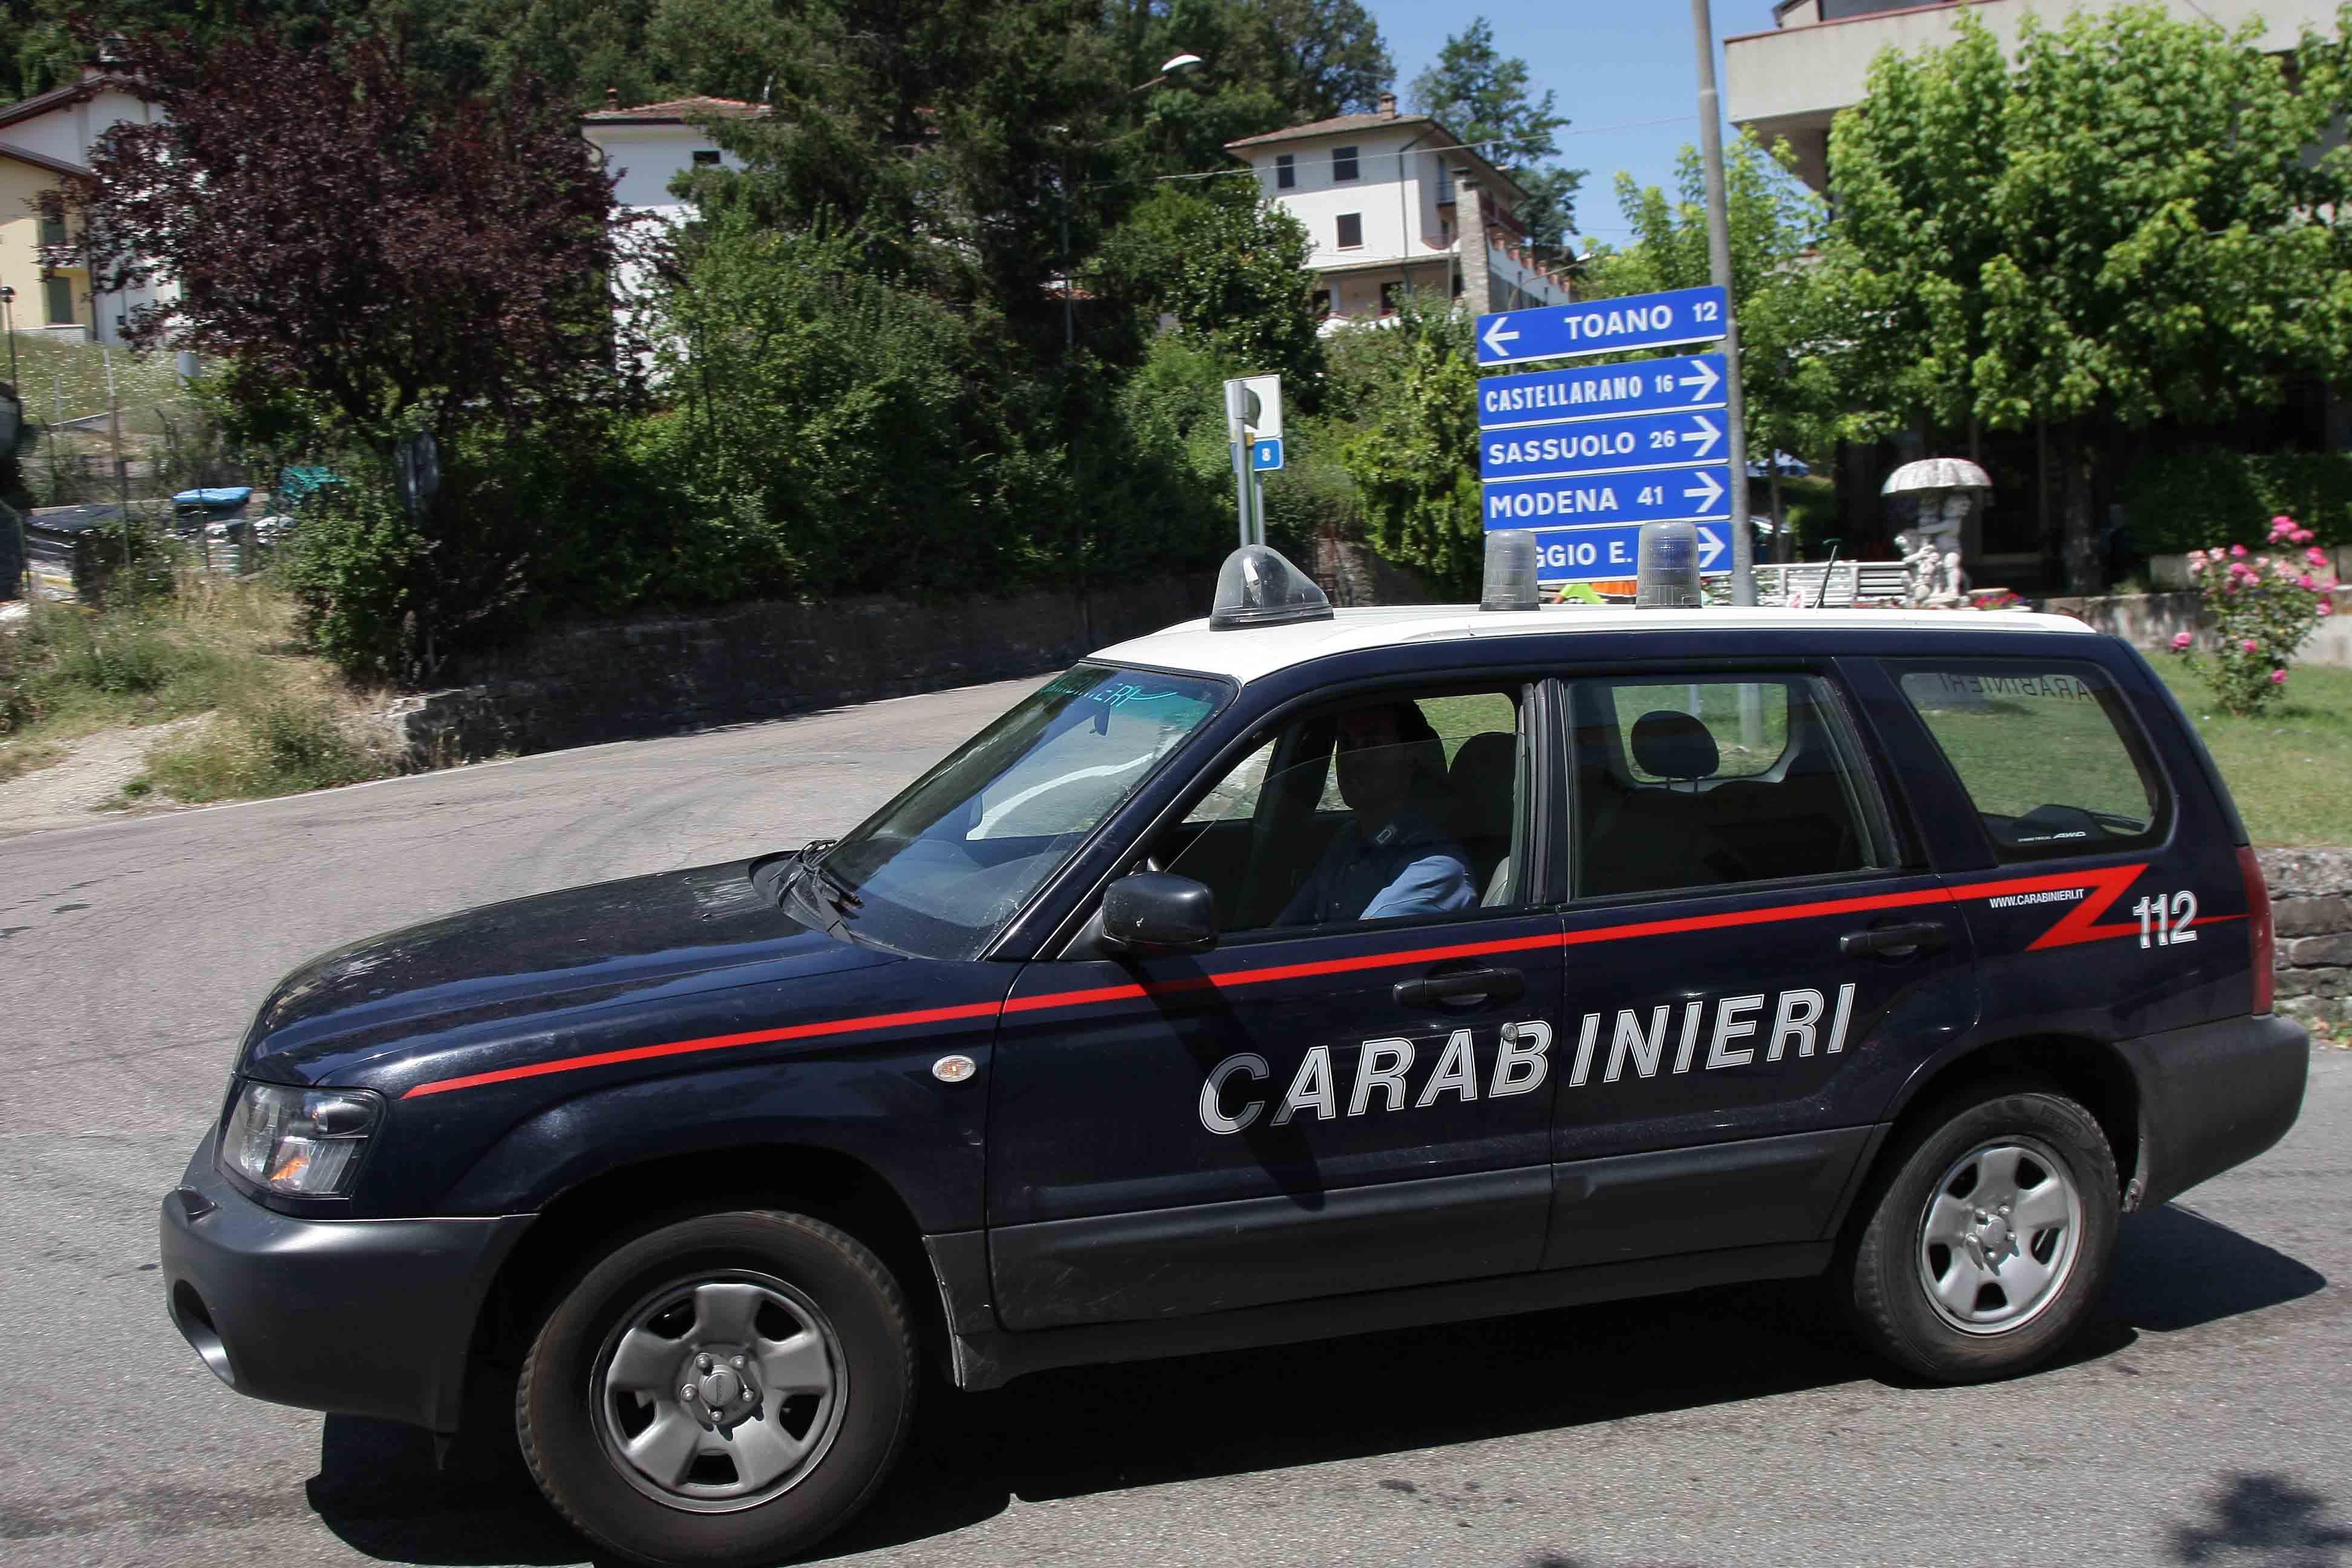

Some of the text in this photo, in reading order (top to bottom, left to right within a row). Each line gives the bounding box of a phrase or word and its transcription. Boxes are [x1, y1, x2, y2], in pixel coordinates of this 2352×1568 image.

[1564, 301, 1717, 339] TOANO 12
[1485, 374, 1674, 413] CASTELLARANO 16
[1488, 430, 1676, 465] SASSUOLO 26
[1489, 486, 1664, 518] MODENA 41
[1536, 541, 1633, 568] GGIO E.
[2132, 890, 2198, 949] 112
[1199, 982, 1856, 1135] CARABINIERI
